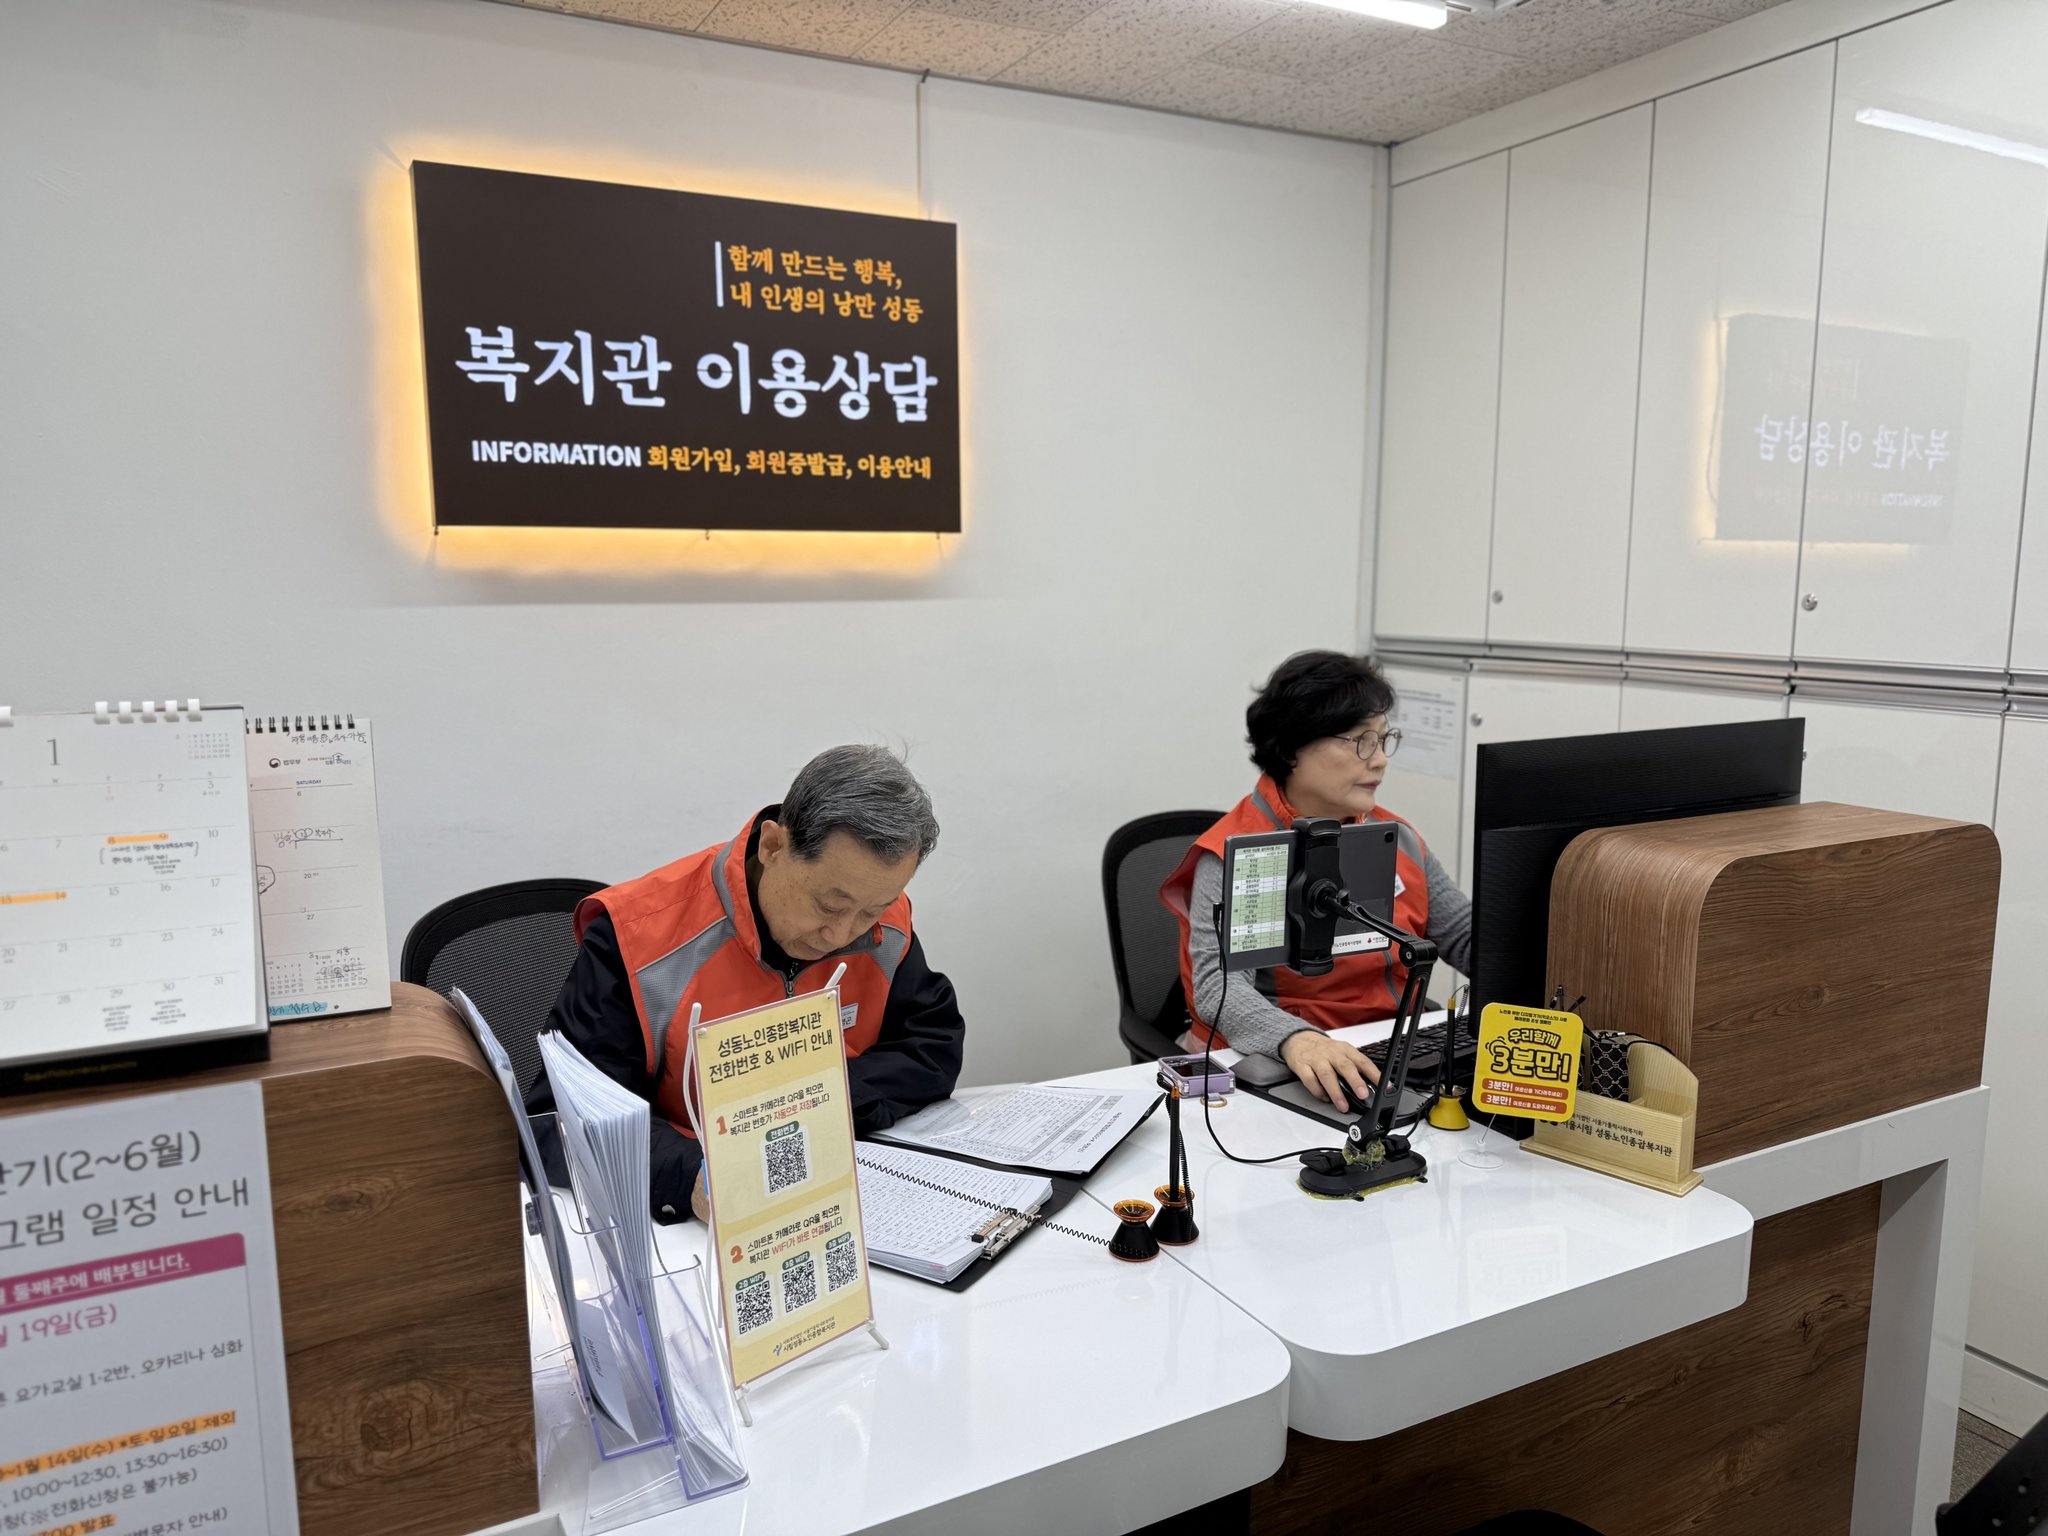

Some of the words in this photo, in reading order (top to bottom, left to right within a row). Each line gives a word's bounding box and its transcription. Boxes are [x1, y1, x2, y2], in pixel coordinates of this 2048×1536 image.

[728, 245, 773, 274] 함께
[781, 251, 847, 280] 만드는
[854, 259, 902, 289] 행복,
[730, 282, 752, 308] 내
[761, 285, 825, 315] 인생의
[834, 291, 875, 320] 낭만
[882, 296, 924, 323] 성동
[455, 325, 672, 407] 복지관
[696, 341, 938, 423] 이용상담
[472, 440, 641, 467] INFORMATION
[647, 445, 740, 475] 회원가입,
[746, 449, 852, 480] 회원증발급,
[857, 456, 931, 480] 이용안내
[46, 738, 61, 765] 1
[157, 783, 165, 792] 2
[207, 780, 214, 789] 3
[55, 839, 62, 848] 7
[208, 829, 219, 838] 10
[108, 886, 120, 897] 15
[160, 882, 172, 892] 16
[210, 878, 221, 888] 17
[161, 932, 174, 942] 23
[211, 927, 224, 937] 24
[57, 943, 68, 953] 21
[109, 937, 122, 948] 22
[161, 982, 175, 992] 30
[214, 976, 224, 986] 31
[57, 994, 71, 1005] 28
[110, 988, 124, 999] 29
[718, 1011, 822, 1058] 성동노인종합복지관
[1508, 1028, 1561, 1049] 우리함께
[708, 1053, 762, 1084] 전화번호
[764, 1050, 775, 1065] &
[777, 1039, 808, 1061] WIFI
[811, 1029, 833, 1051] 안내
[1491, 1043, 1572, 1082] 3분만!
[1487, 1080, 1513, 1092] 3분만!
[732, 1104, 759, 1123] 스마트폰
[760, 1096, 786, 1112] 카메라로
[787, 1089, 804, 1102] QR을
[805, 1082, 824, 1096] 찍으면
[1486, 1094, 1512, 1106] 3분만!
[730, 1120, 751, 1136] 복지관
[752, 1115, 773, 1131] 번호가
[773, 1105, 798, 1121] 자동으로
[799, 1092, 830, 1112] 저장됩니다
[716, 1115, 727, 1135] 1
[1595, 1127, 1673, 1157] 성동노인종합복지관
[82, 1192, 158, 1237] 일정
[174, 1177, 249, 1219] 안내
[747, 1235, 774, 1253] 스마트폰
[775, 1223, 801, 1240] 카메라로
[803, 1214, 820, 1228] QR을
[821, 1204, 840, 1219] 찍으면
[730, 1245, 743, 1264] 2
[750, 1248, 770, 1265] 복지관
[771, 1238, 796, 1256] WIFI가
[797, 1231, 810, 1244] 바로
[795, 1251, 809, 1263] WIFI
[13, 1270, 88, 1301] 둘째주에
[93, 1252, 191, 1285] 배부됩니다.
[750, 1273, 764, 1285] WIFI
[20, 1303, 118, 1343] 19일(금)
[15, 1375, 83, 1403] 요가교실
[141, 1348, 205, 1375] 오카리나
[210, 1338, 243, 1359] 심화
[47, 1441, 115, 1468] 14일(수)
[202, 1410, 236, 1428] 제외
[125, 1436, 228, 1475] 13:30~16:30)
[142, 1467, 198, 1493] 불가능)
[81, 1515, 115, 1534] 발표
[188, 1507, 228, 1529] 안내)
